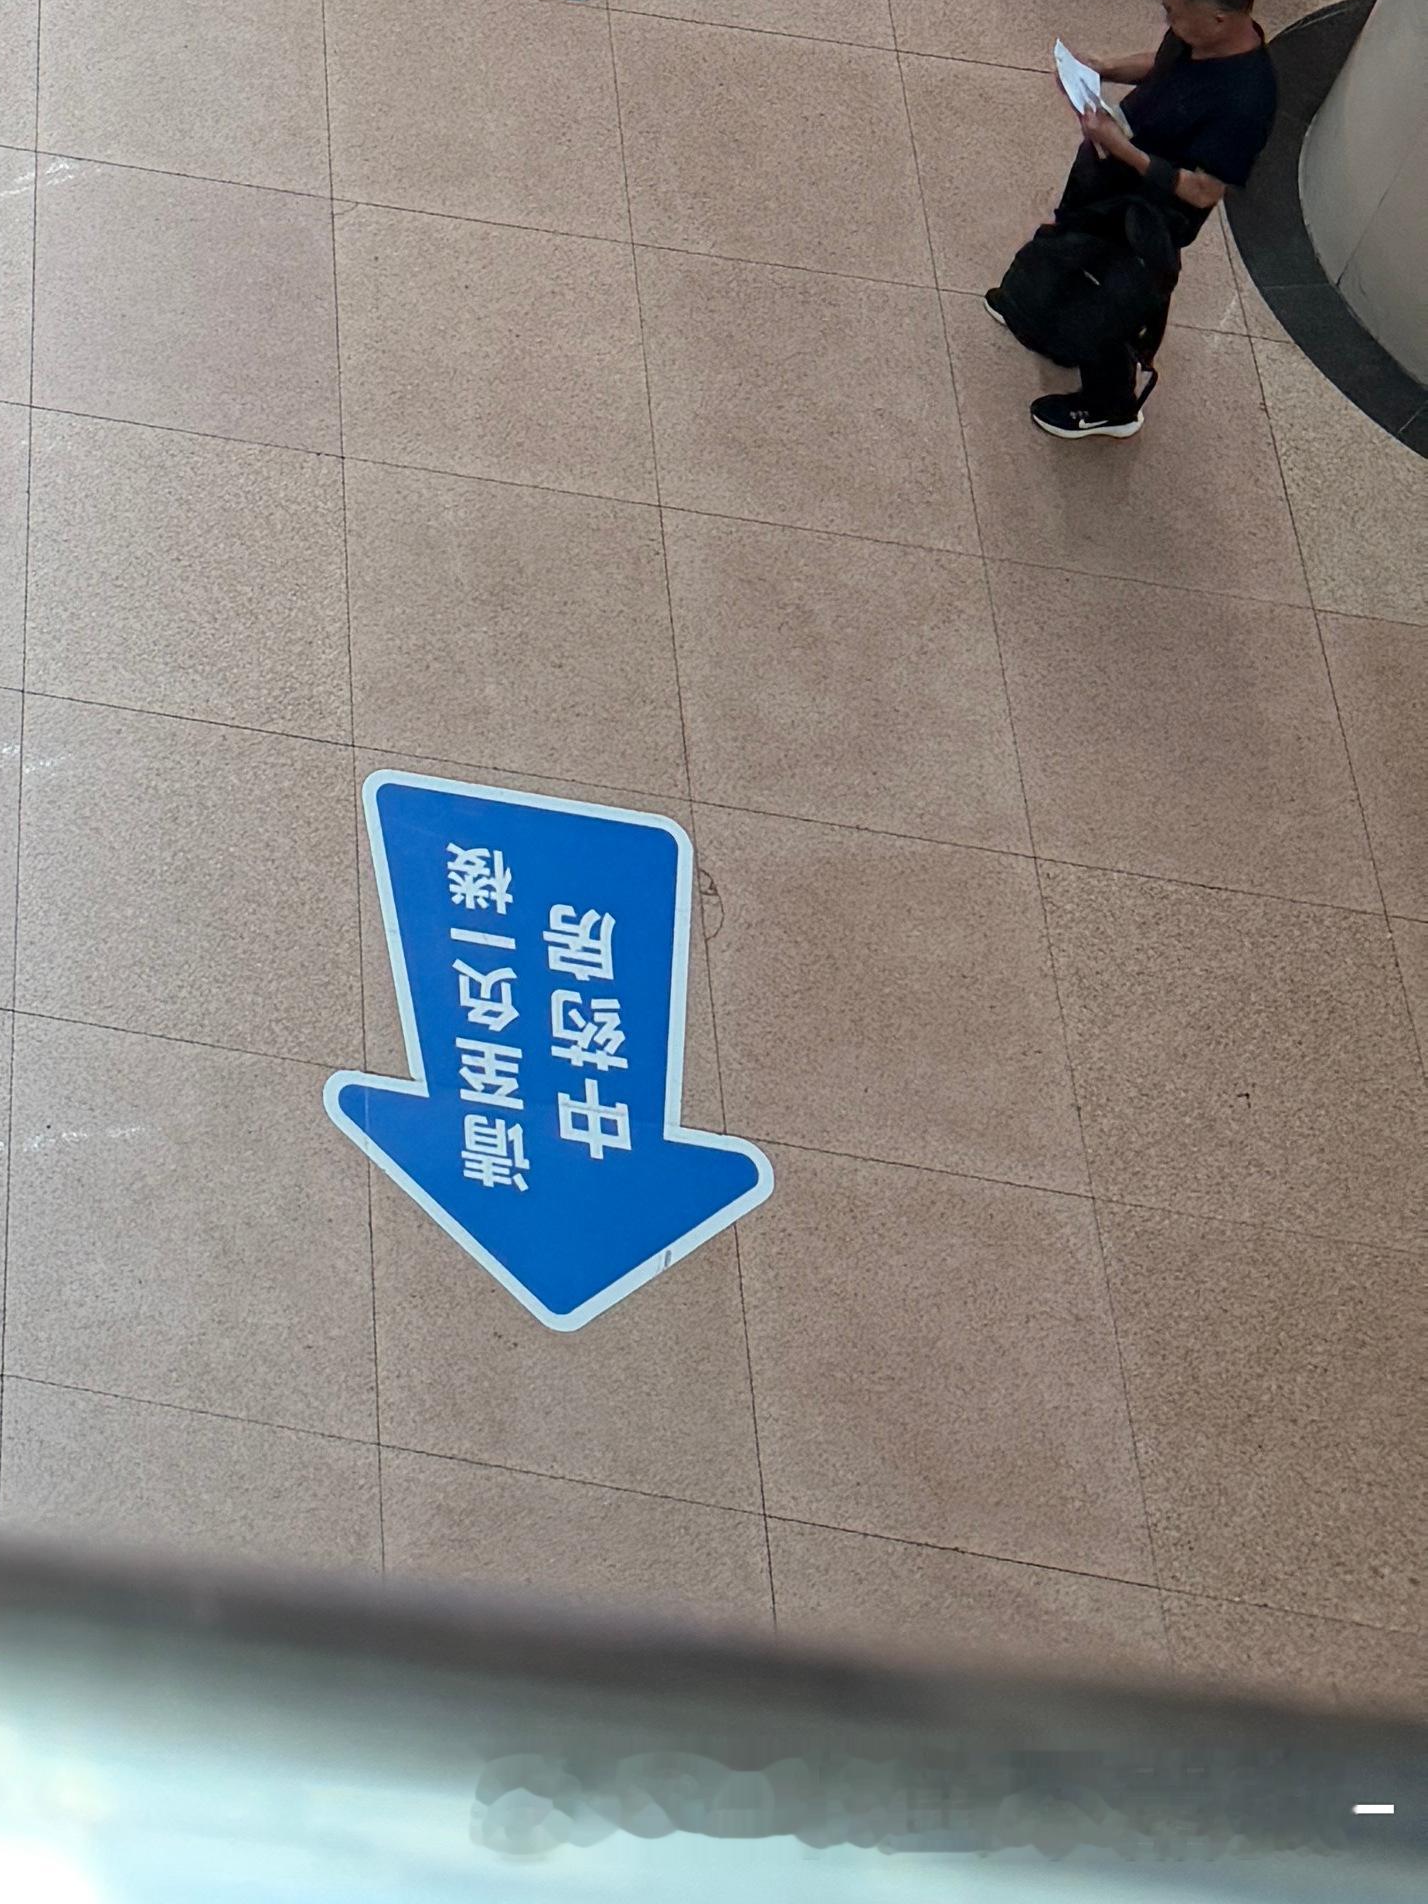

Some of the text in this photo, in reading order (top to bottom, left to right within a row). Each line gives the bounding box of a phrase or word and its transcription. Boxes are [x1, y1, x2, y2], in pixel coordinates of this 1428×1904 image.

[446, 842, 530, 1193] 请至负一楼
[543, 903, 632, 1160] 中药房
